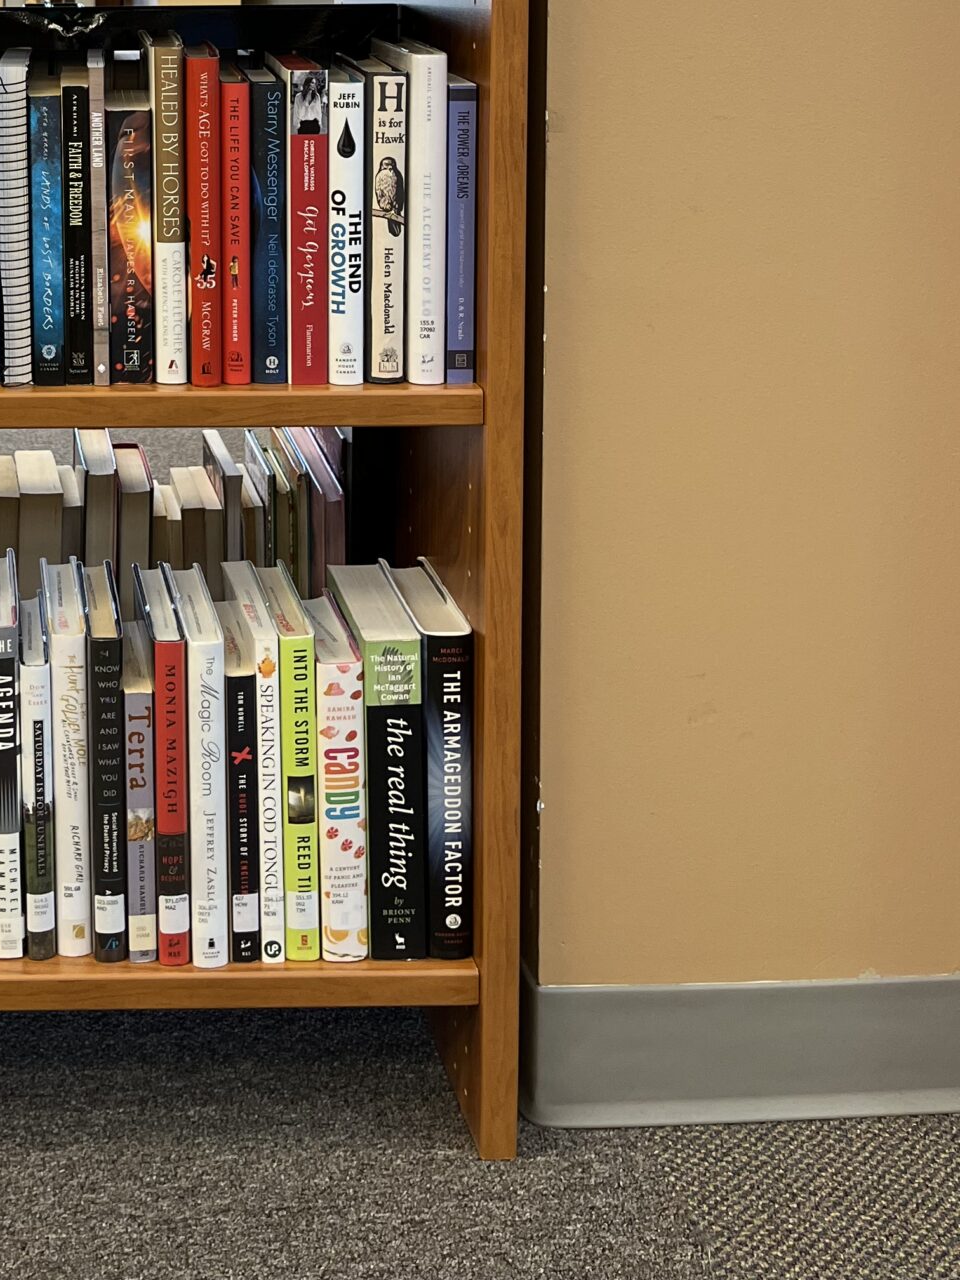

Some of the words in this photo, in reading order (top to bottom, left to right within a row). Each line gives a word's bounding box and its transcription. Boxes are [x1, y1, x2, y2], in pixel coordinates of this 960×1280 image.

[333, 101, 360, 109] RUBIN
[338, 93, 356, 101] JEFF
[331, 189, 346, 216] OF
[348, 210, 362, 247] THE
[331, 222, 346, 315] GROWTH
[348, 252, 363, 294] END
[292, 648, 307, 681] INTO
[293, 687, 308, 713] THE
[443, 670, 462, 710] THE
[294, 717, 310, 768] STORM
[386, 717, 413, 759] the
[387, 762, 413, 817] real
[443, 711, 463, 834] ARMAGEDDON
[381, 822, 413, 892] thing
[444, 840, 463, 908] FACTOR
